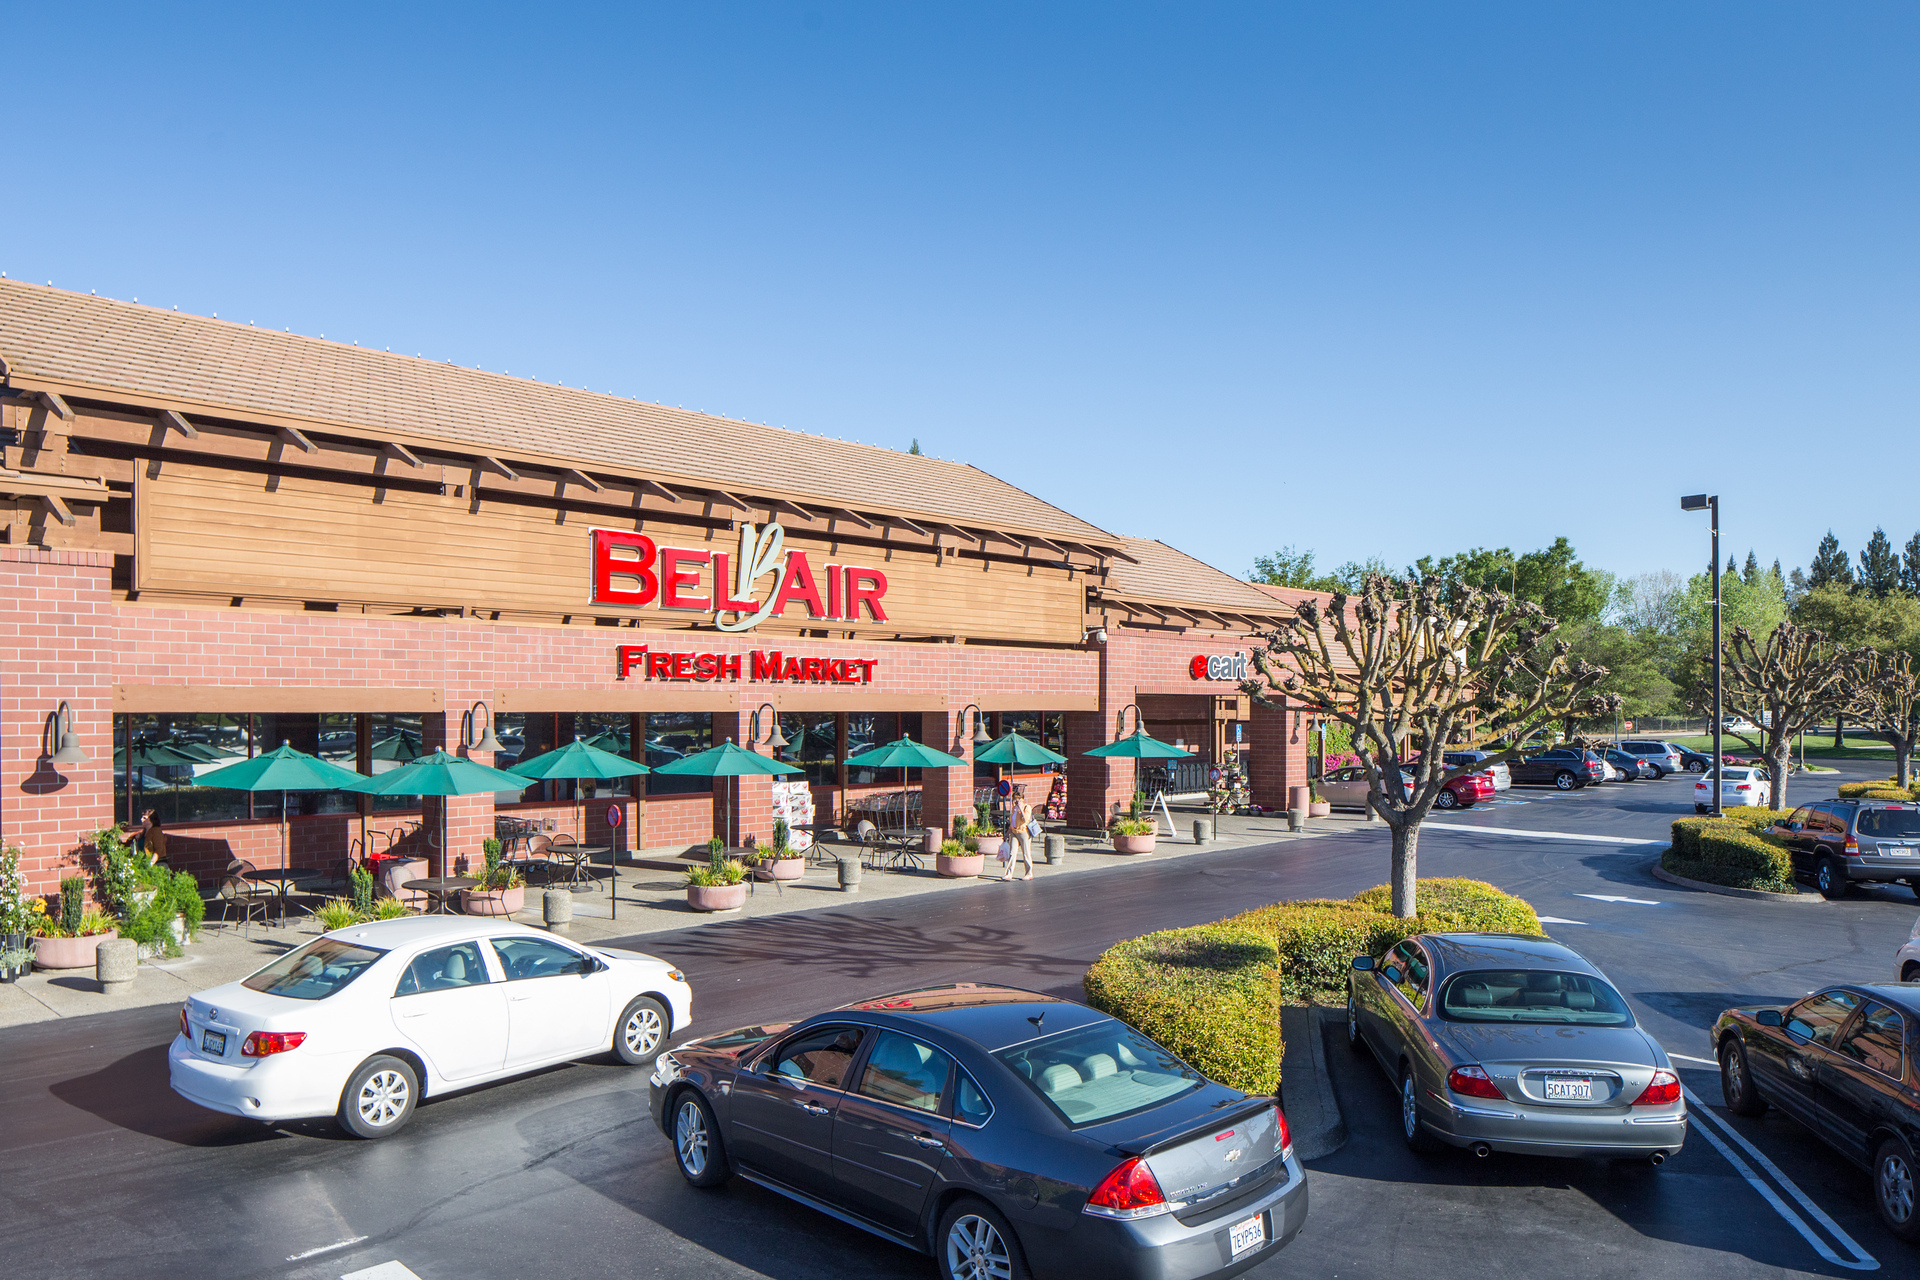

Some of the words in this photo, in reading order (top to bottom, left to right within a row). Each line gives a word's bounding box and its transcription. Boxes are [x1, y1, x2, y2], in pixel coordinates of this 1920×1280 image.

[588, 526, 759, 613] BEL
[771, 549, 889, 623] AIR
[616, 644, 742, 681] FRESH
[750, 650, 878, 684] MARKET
[1548, 1084, 1590, 1096] 5CAT307
[1232, 1223, 1262, 1249] 7EYP536
